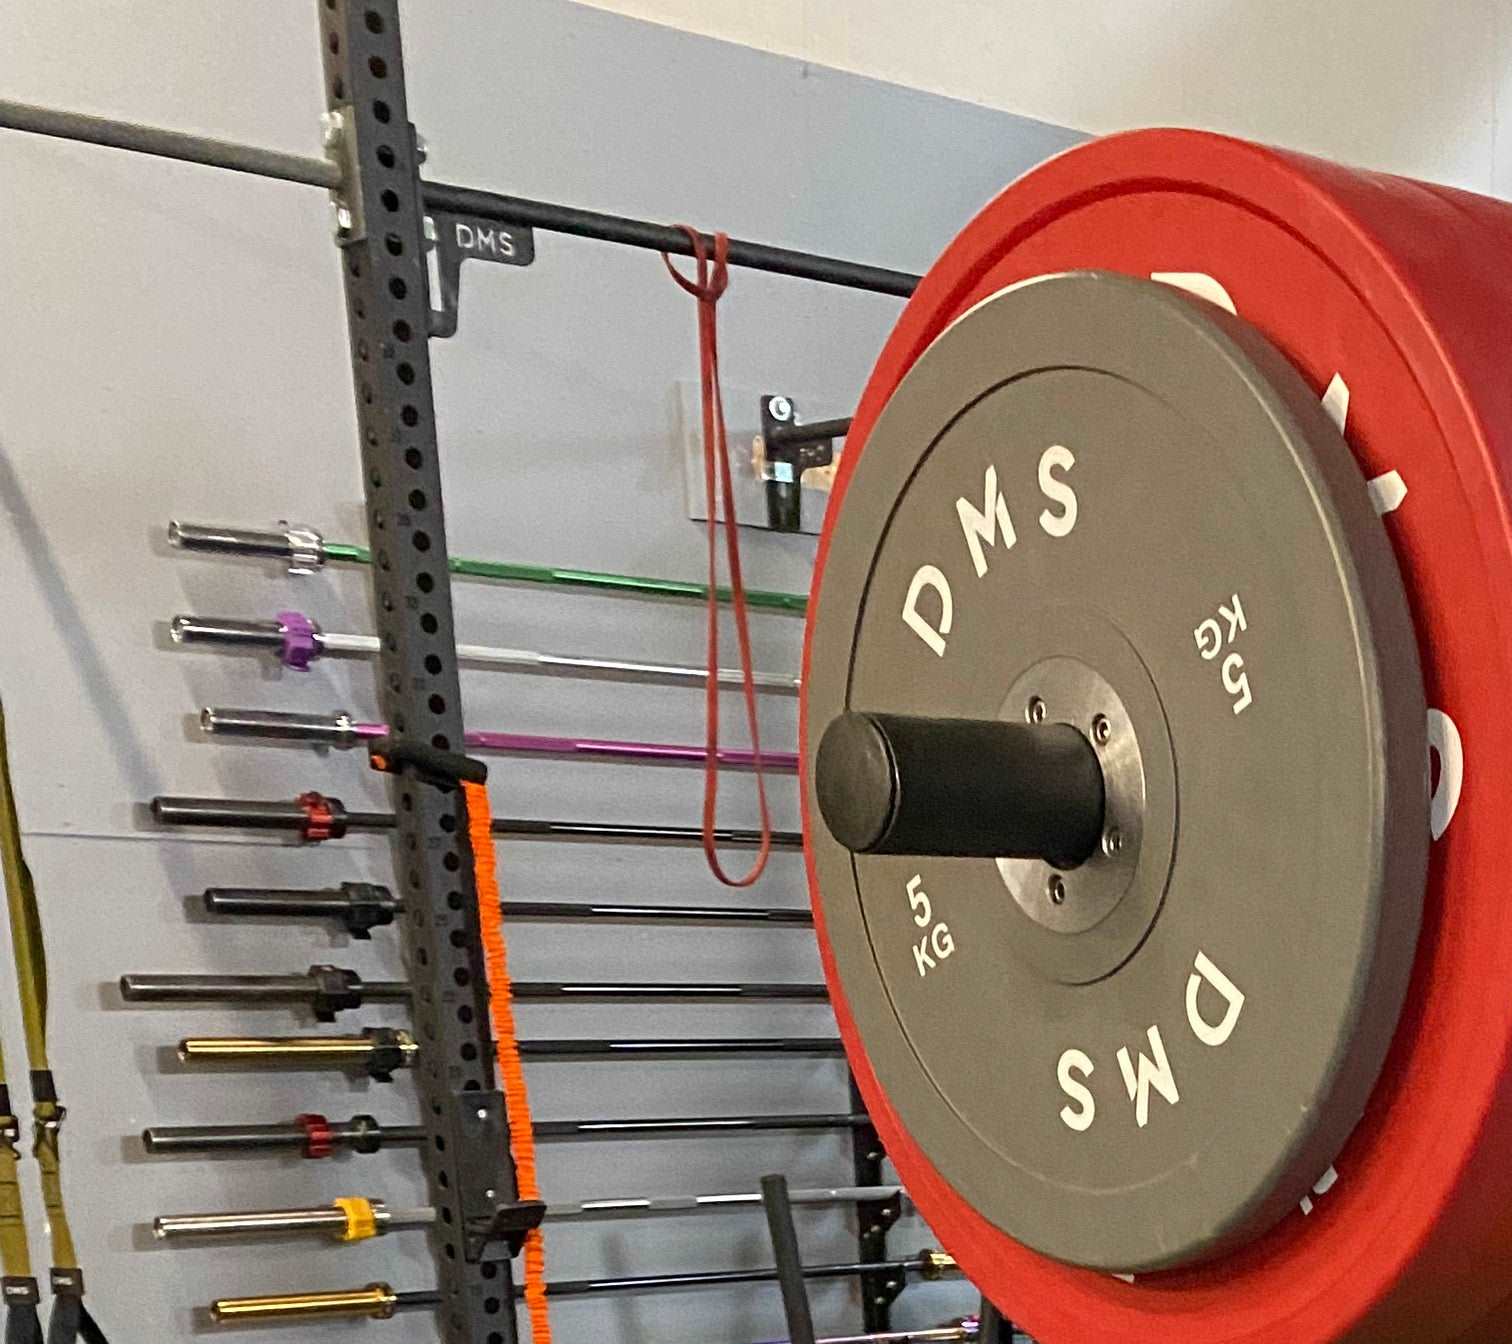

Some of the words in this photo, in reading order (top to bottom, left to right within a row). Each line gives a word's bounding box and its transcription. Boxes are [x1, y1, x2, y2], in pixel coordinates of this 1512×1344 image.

[455, 223, 515, 256] DMS
[901, 444, 1078, 657] DMS
[1194, 594, 1248, 657] KG
[1221, 658, 1252, 715] 5
[905, 874, 932, 926] 5
[912, 921, 955, 977] KG
[1055, 951, 1245, 1132] DMS
